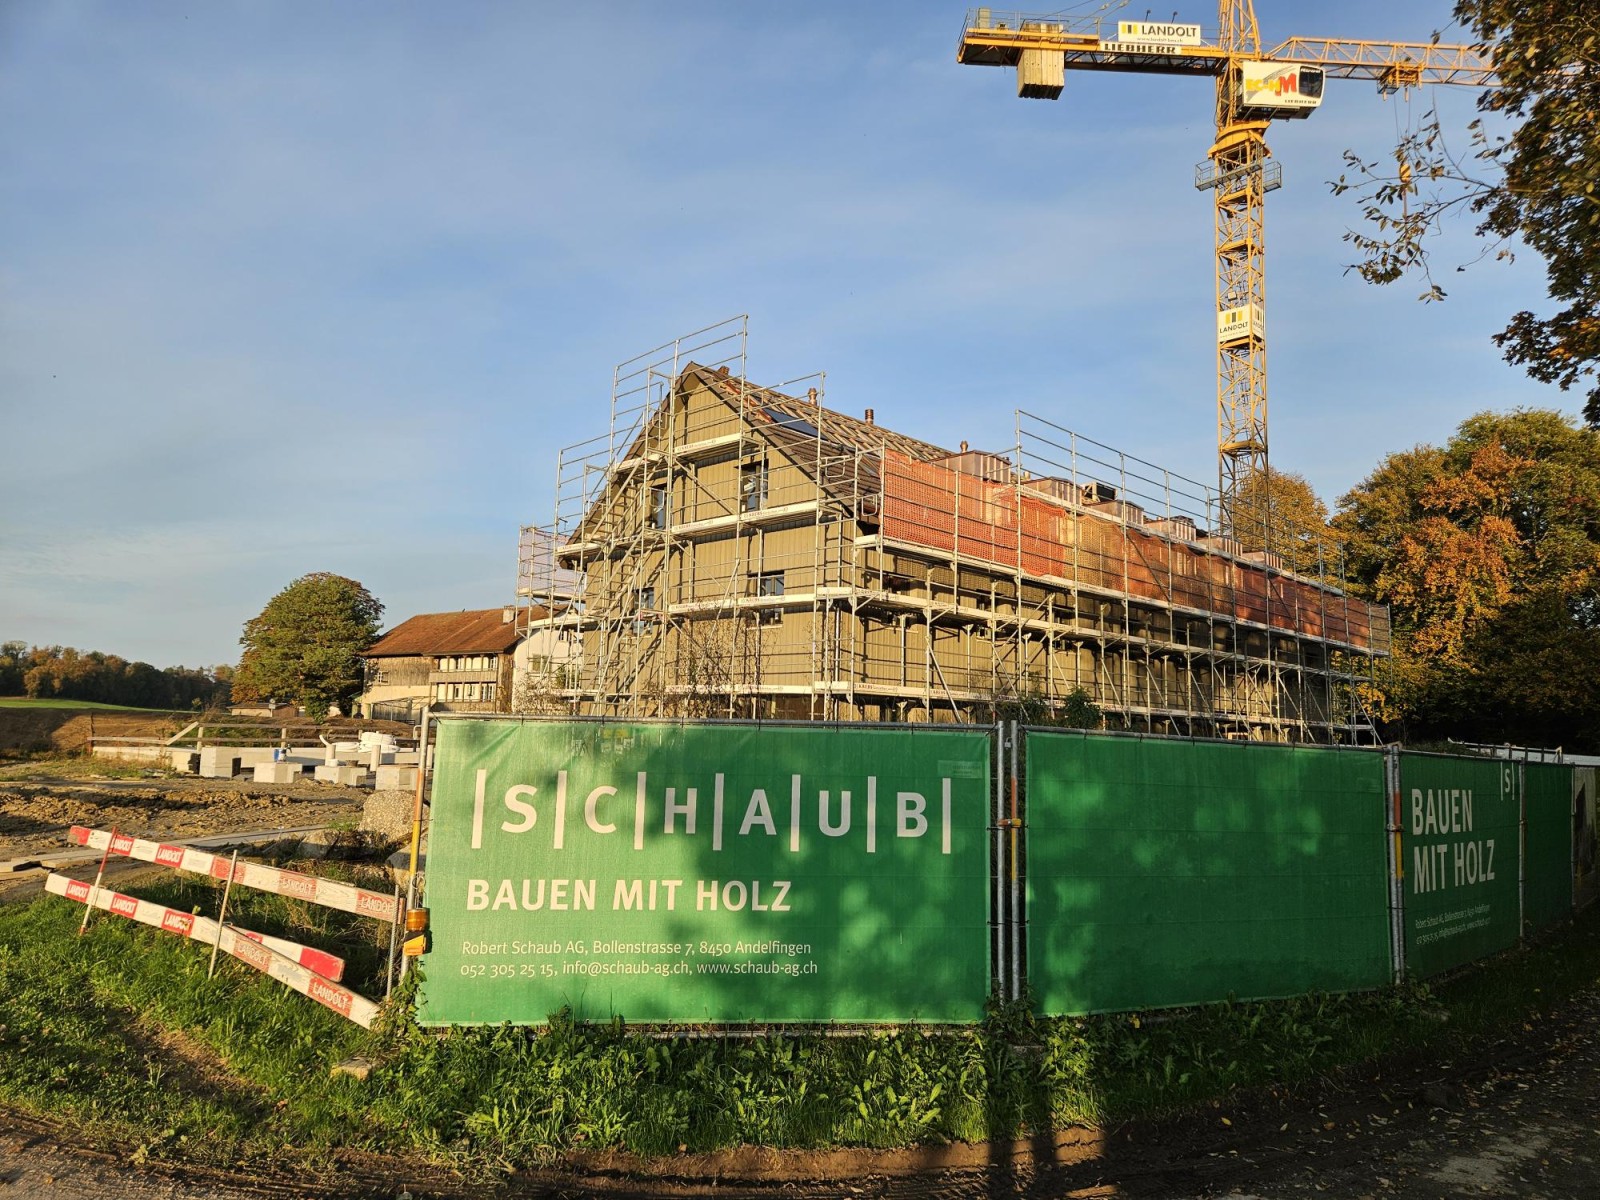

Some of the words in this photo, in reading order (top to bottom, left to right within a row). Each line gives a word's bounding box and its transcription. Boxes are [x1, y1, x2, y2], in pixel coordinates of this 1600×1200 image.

[1141, 25, 1197, 37] LANDOLT
[1104, 43, 1176, 54] LIEBHERR
[1219, 321, 1248, 333] LANDOLT
[1411, 788, 1473, 835] BAUEN
[1413, 844, 1448, 894] MIT
[1454, 839, 1495, 887] HOLZ
[466, 879, 596, 911] BAUEN
[612, 879, 683, 911] MIT
[696, 880, 792, 912] HOLZ
[462, 941, 507, 955] Robert
[511, 941, 562, 955] Schaub
[565, 942, 589, 956] AG,
[593, 941, 682, 955] Bollenstrasse
[685, 943, 695, 957] 7,
[699, 941, 731, 957] 8450
[735, 940, 811, 957] Andelfingen
[460, 963, 486, 977] 052
[490, 964, 516, 978] 305
[520, 964, 536, 978] 25
[540, 964, 558, 977] 15,
[562, 961, 693, 978] info@schaub-ag.ch,
[696, 961, 818, 977] www.schaub-ag.ch
